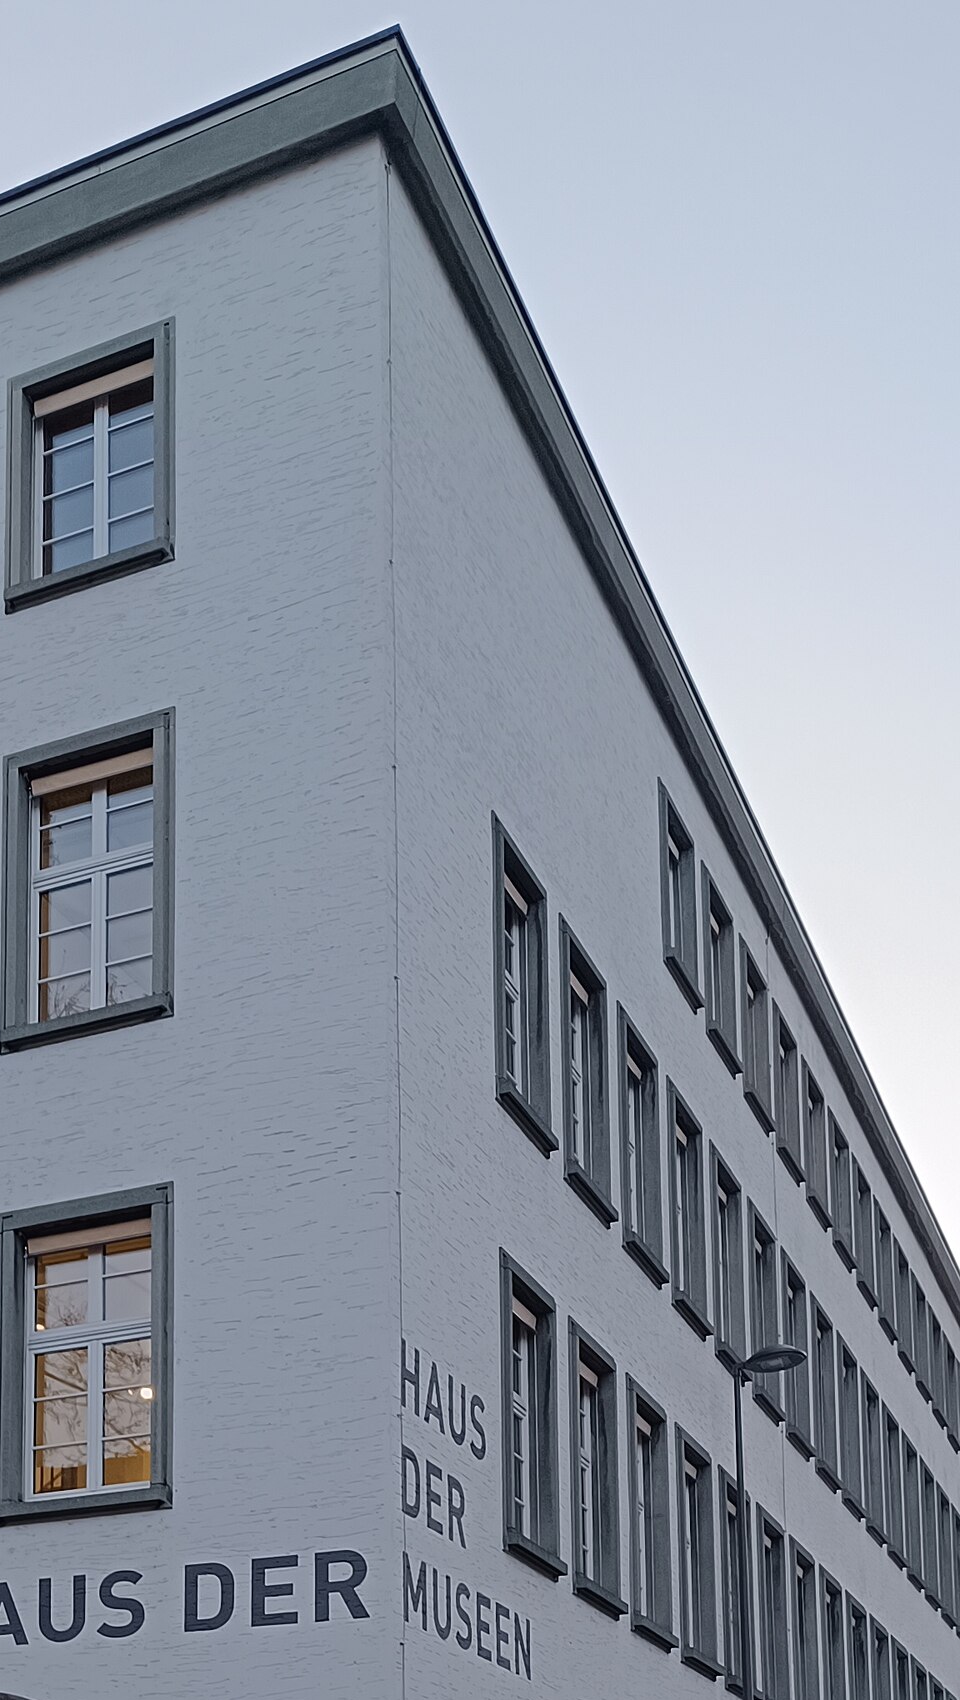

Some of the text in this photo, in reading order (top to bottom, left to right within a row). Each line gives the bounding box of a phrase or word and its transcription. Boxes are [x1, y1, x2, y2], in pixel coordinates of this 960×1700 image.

[401, 1338, 487, 1460] HAUS
[401, 1443, 467, 1549] DER
[183, 1550, 371, 1633] DER
[402, 1551, 532, 1681] MUSEEN
